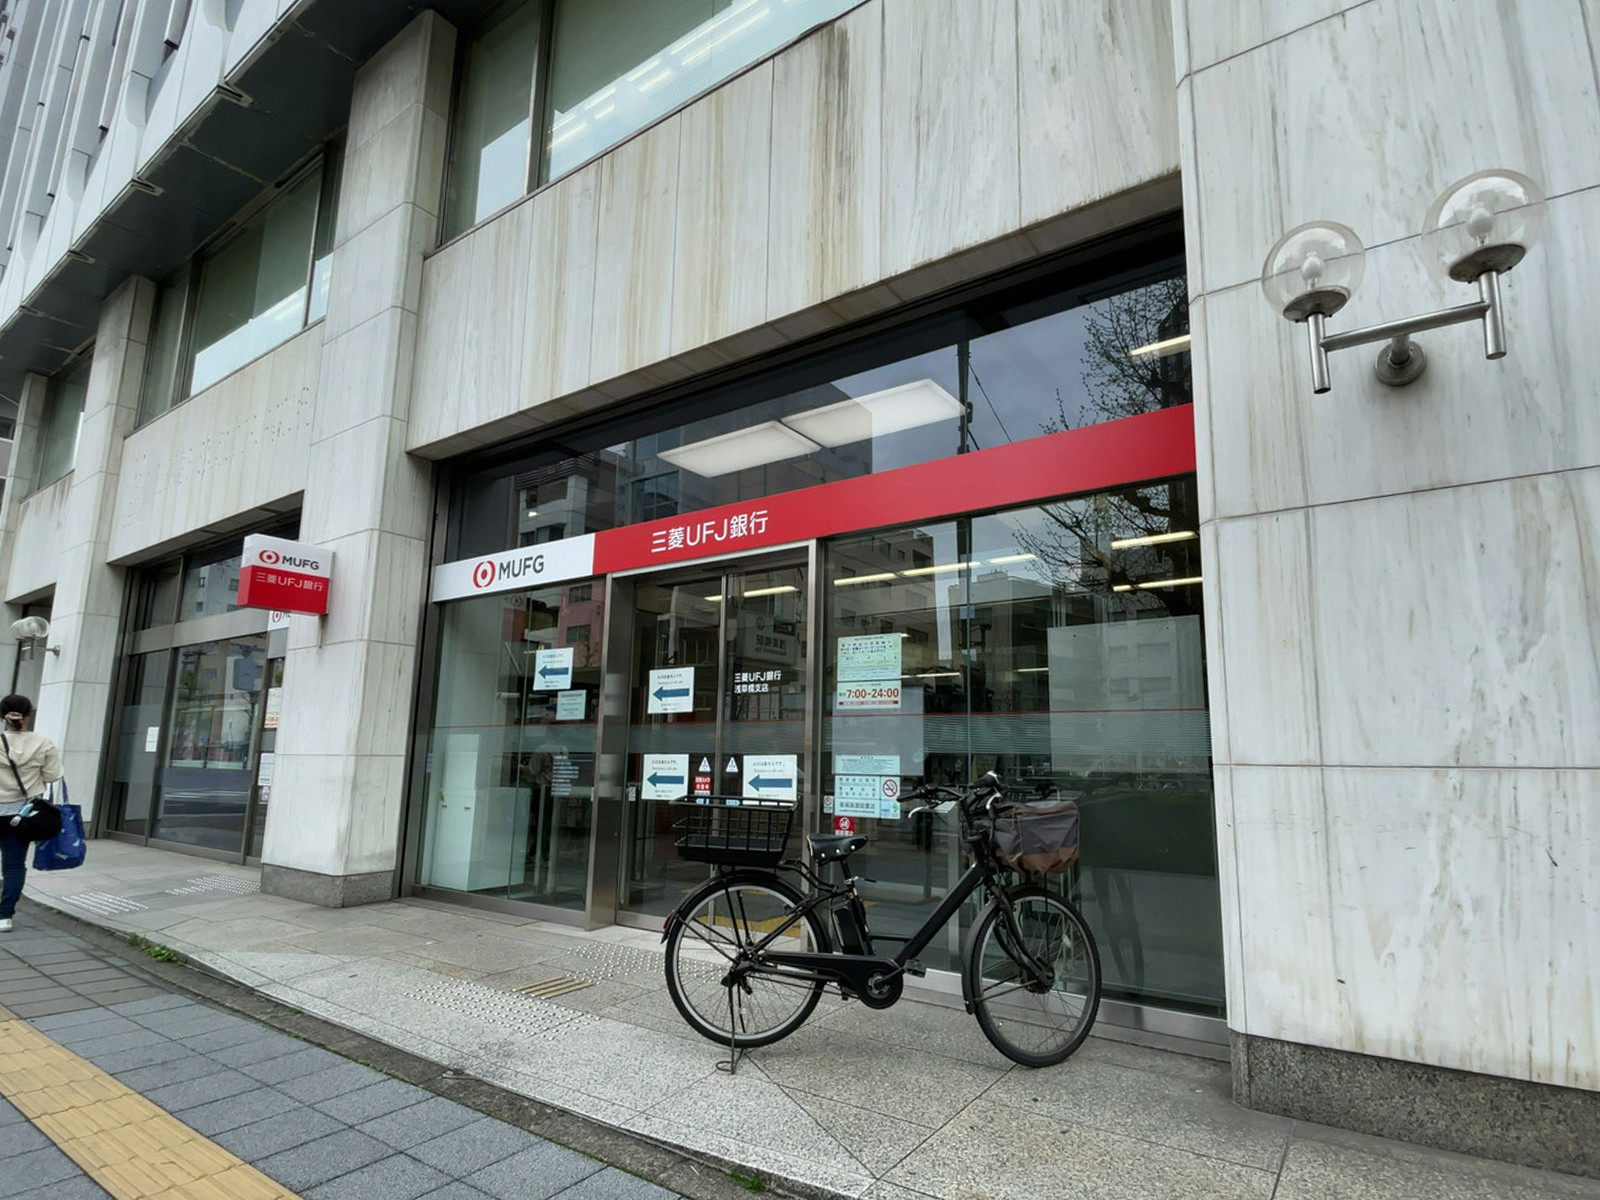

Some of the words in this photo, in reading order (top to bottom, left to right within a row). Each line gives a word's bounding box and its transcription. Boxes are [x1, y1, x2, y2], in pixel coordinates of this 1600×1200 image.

[651, 510, 768, 553] 三菱UFJ銀行
[282, 555, 319, 570] MUFG
[498, 555, 544, 580] MUFG
[256, 572, 324, 591] 三菱UFJ銀行
[734, 670, 782, 683] 三菱UFJ銀行
